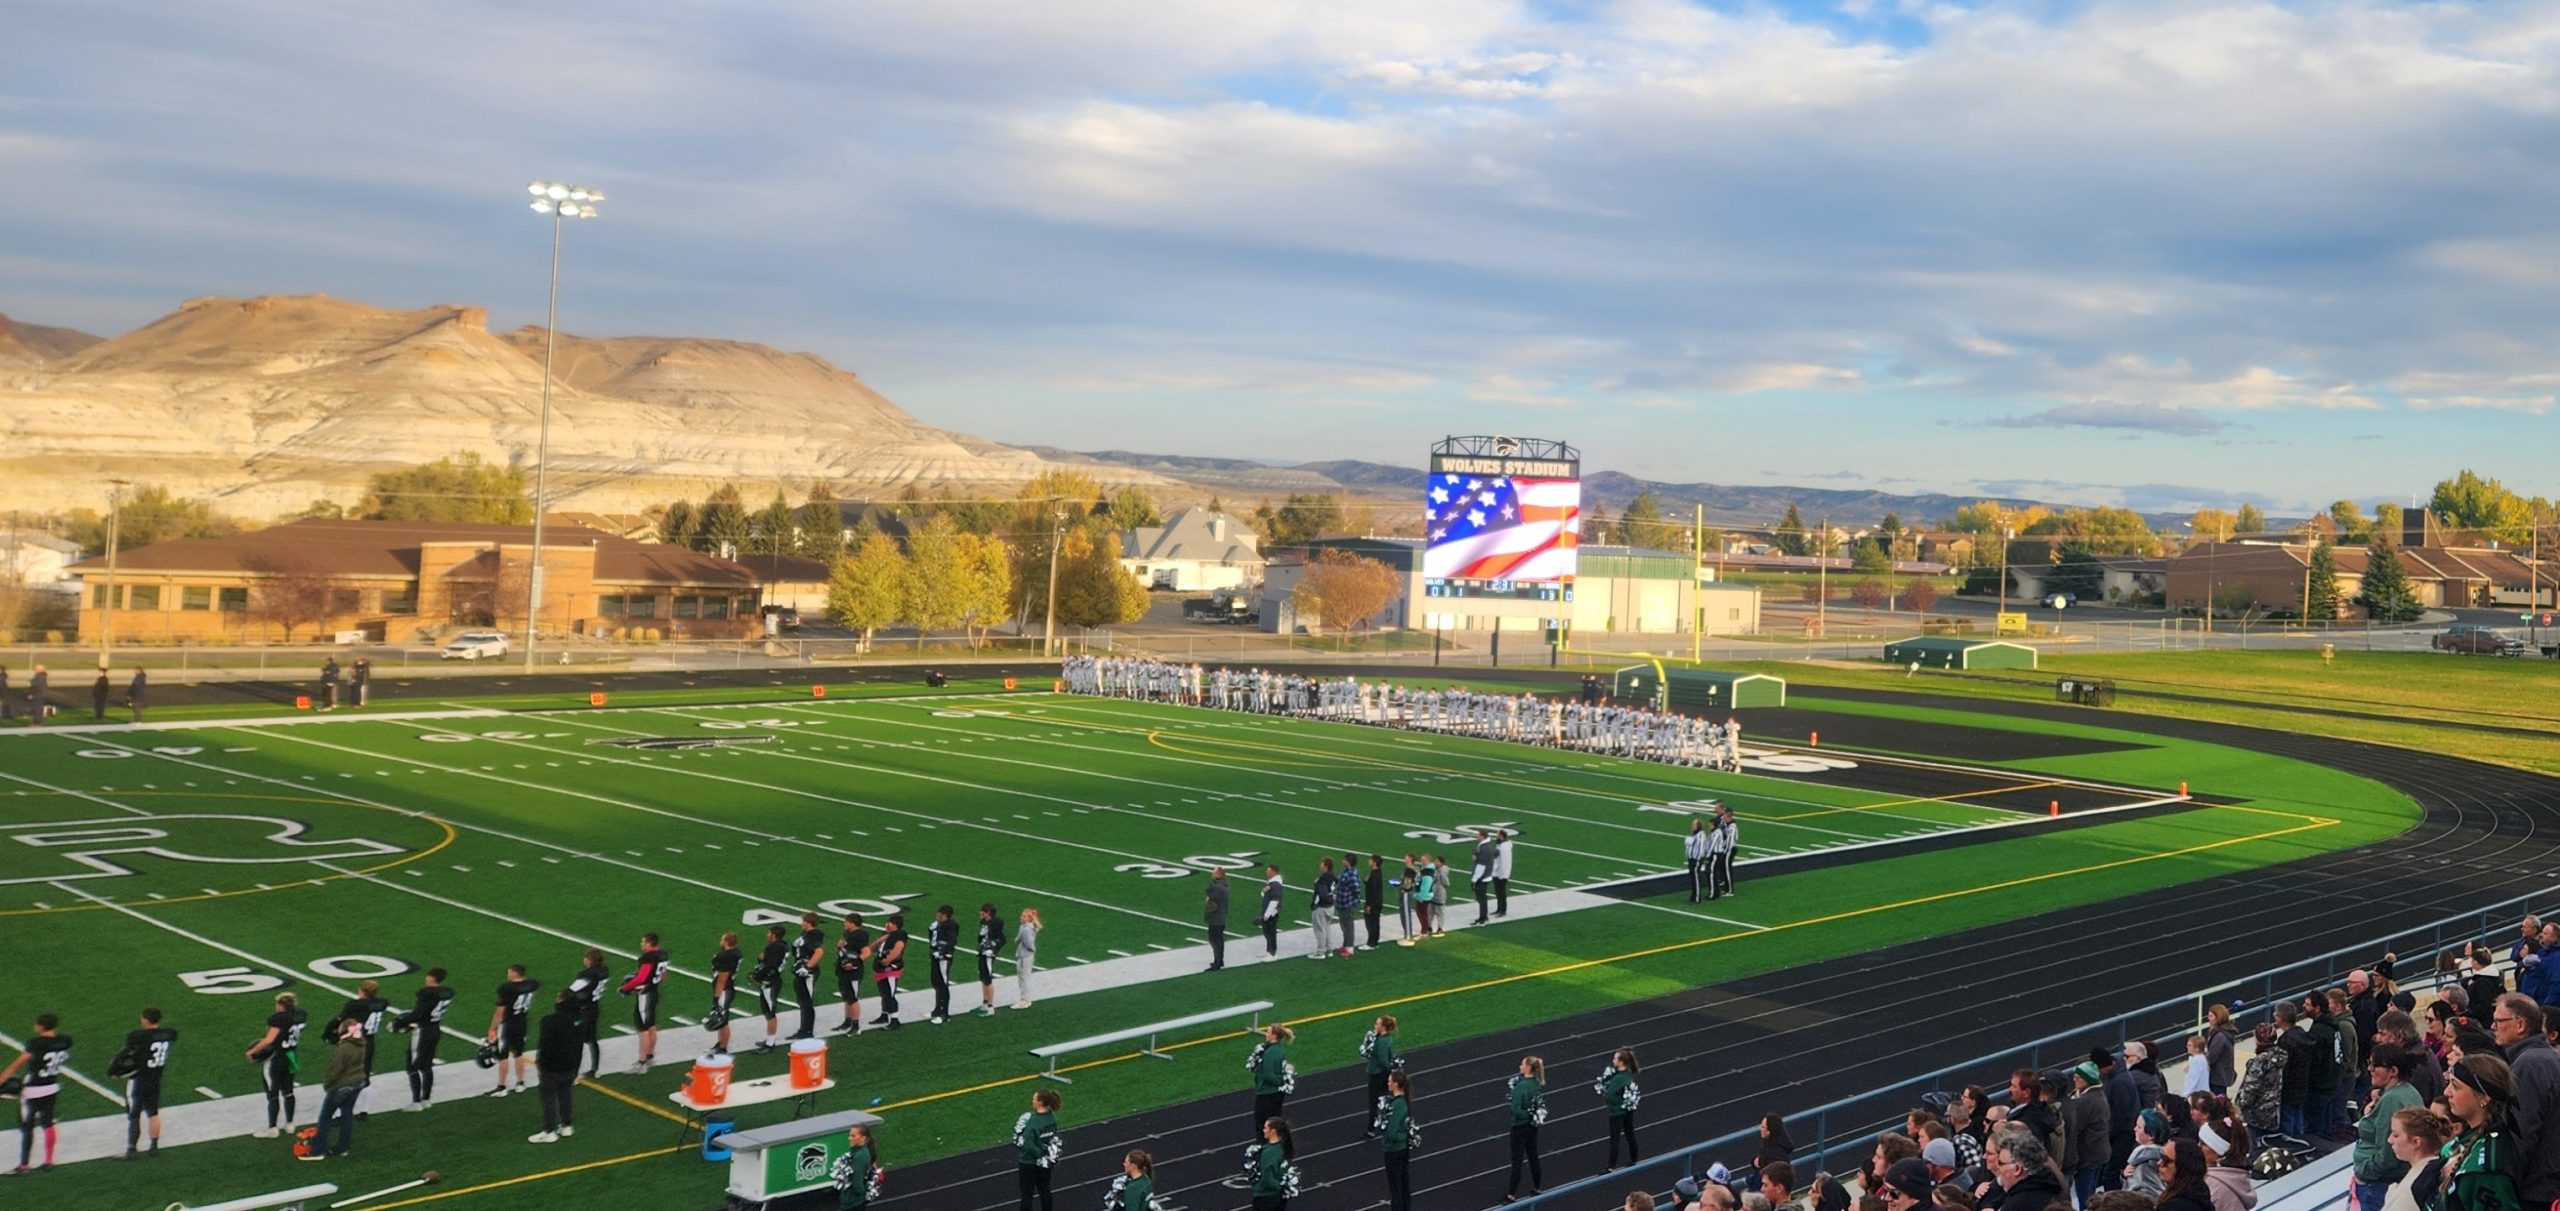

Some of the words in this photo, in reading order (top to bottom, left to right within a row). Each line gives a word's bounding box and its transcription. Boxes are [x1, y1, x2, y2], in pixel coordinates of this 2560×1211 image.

[1441, 458, 1501, 474] WOLVES
[1504, 461, 1571, 477] STADIUM
[1431, 586, 1439, 597] 0
[1491, 579, 1515, 590] 2:31
[1112, 855, 1255, 879] 30
[741, 899, 901, 927] 40
[176, 954, 411, 995] 50
